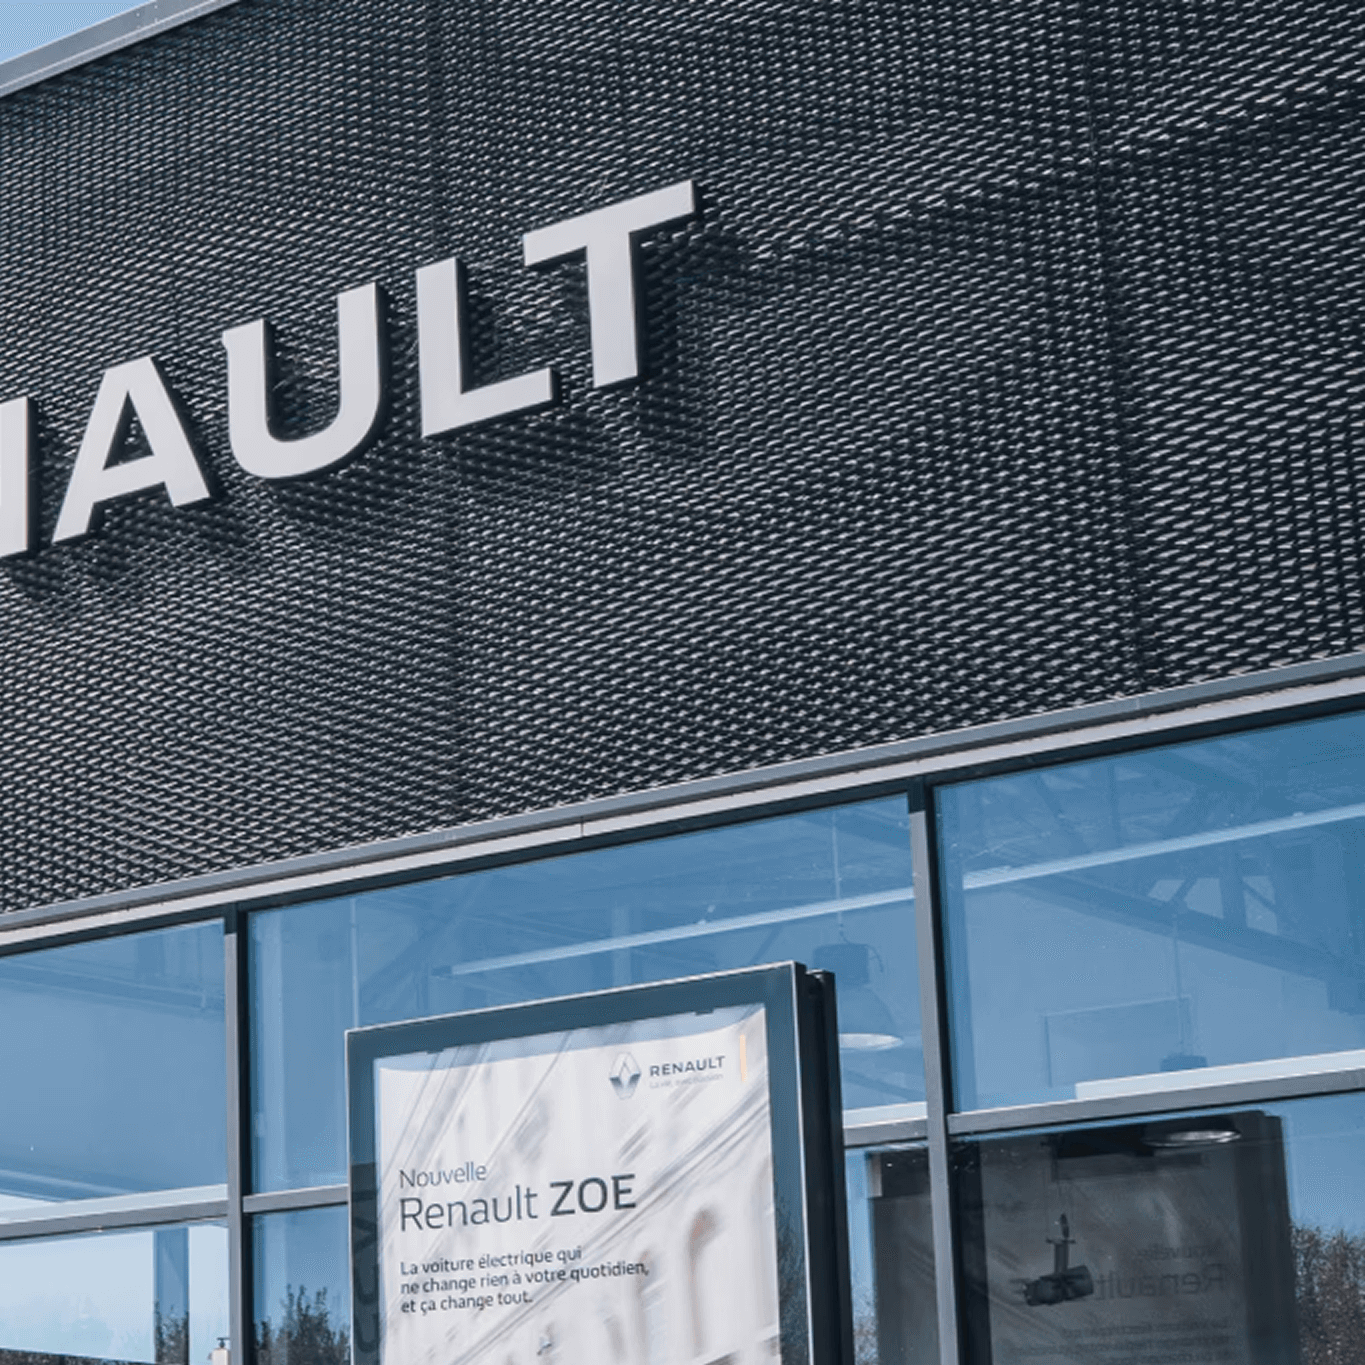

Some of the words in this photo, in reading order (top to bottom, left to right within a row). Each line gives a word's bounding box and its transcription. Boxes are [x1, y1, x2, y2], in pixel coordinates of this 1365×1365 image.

[649, 1055, 725, 1077] RENAULT
[399, 1161, 487, 1189] Nouvelle
[400, 1185, 538, 1231] Renault
[549, 1173, 636, 1217] ZOE
[400, 1261, 418, 1275] La
[422, 1257, 474, 1273] voiture
[478, 1249, 553, 1269] électrique
[556, 1245, 583, 1265] qui
[400, 1281, 420, 1294] ne
[422, 1275, 477, 1295] change
[480, 1272, 509, 1287] rien
[512, 1271, 523, 1285] à
[525, 1268, 569, 1284] votre
[571, 1261, 650, 1283] quotidien,
[400, 1301, 416, 1314] et
[420, 1298, 436, 1315] ça
[440, 1294, 495, 1312] change
[497, 1290, 534, 1305] tout.
